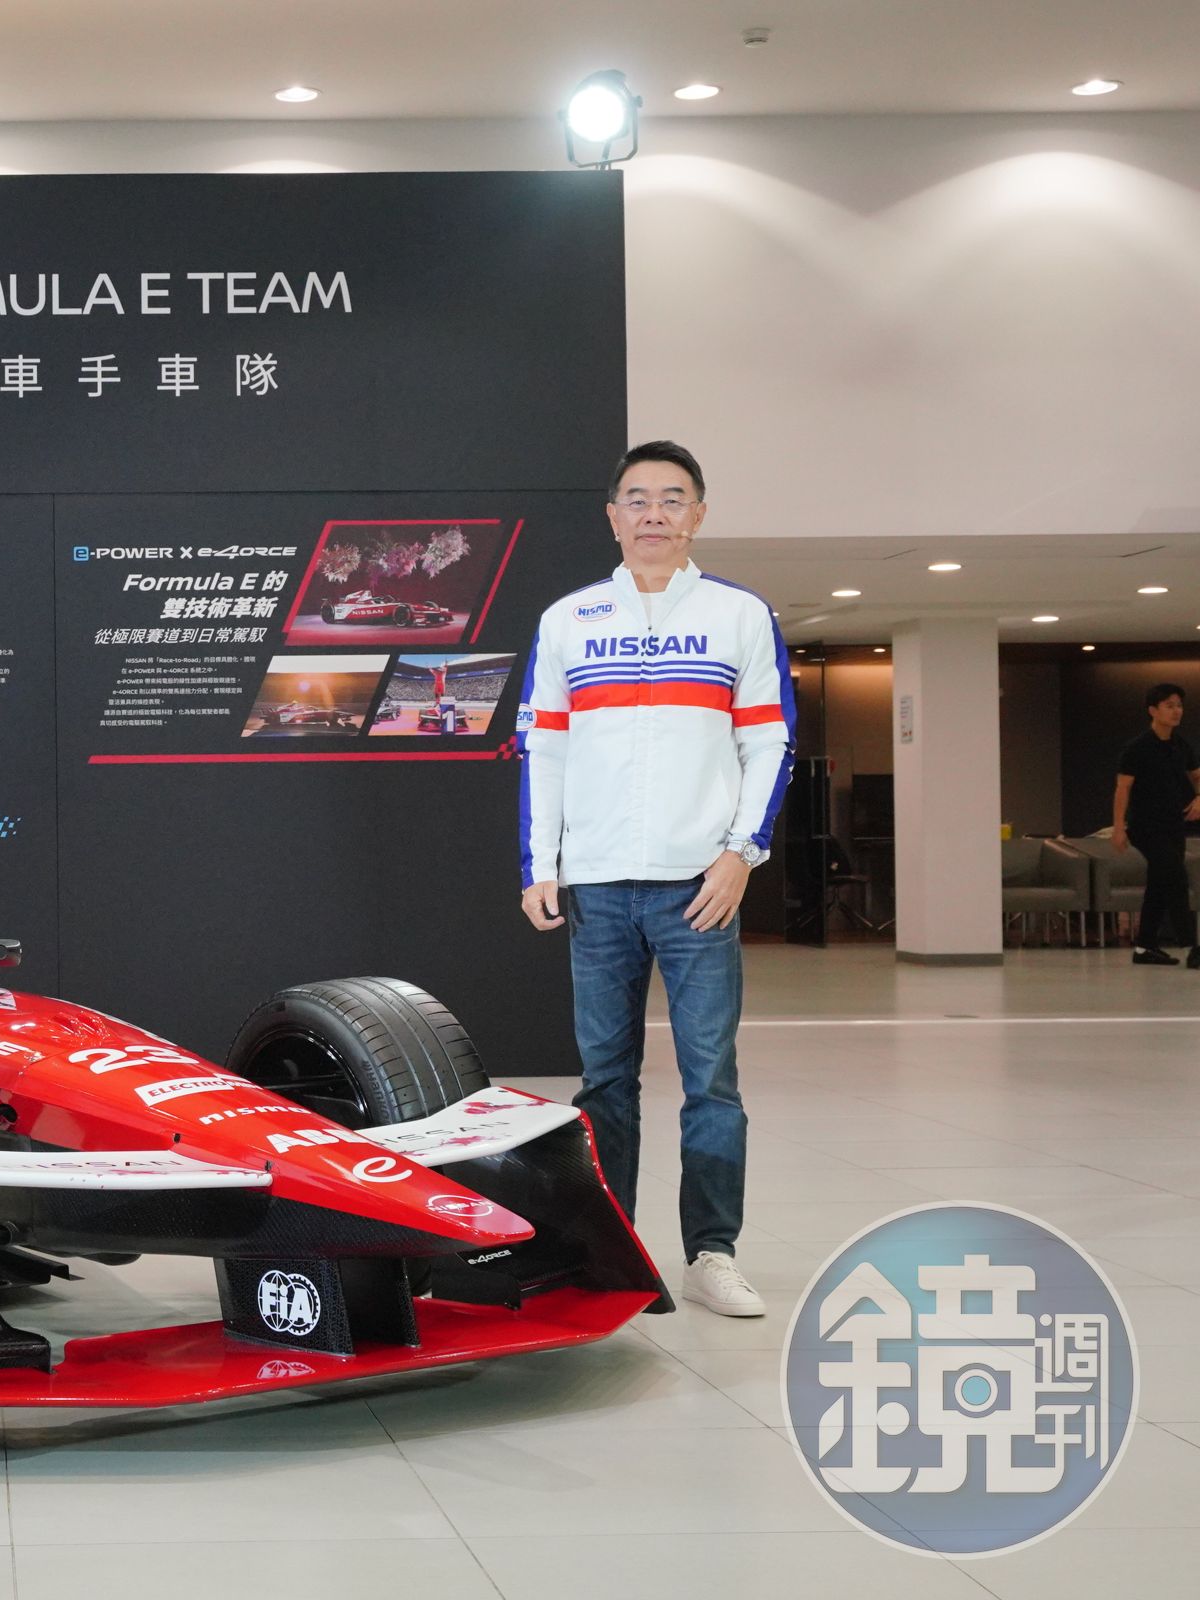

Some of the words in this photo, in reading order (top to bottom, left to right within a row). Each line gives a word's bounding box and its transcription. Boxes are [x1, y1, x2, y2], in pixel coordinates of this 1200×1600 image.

[140, 273, 171, 315] E
[187, 271, 353, 315] TEAM
[123, 572, 234, 592] Formula
[240, 572, 259, 590] E
[262, 570, 288, 592] 的
[160, 596, 279, 619] 雙技術革新
[578, 604, 612, 616] NISMO
[584, 634, 708, 659] NISSAN
[68, 1045, 200, 1075] 23
